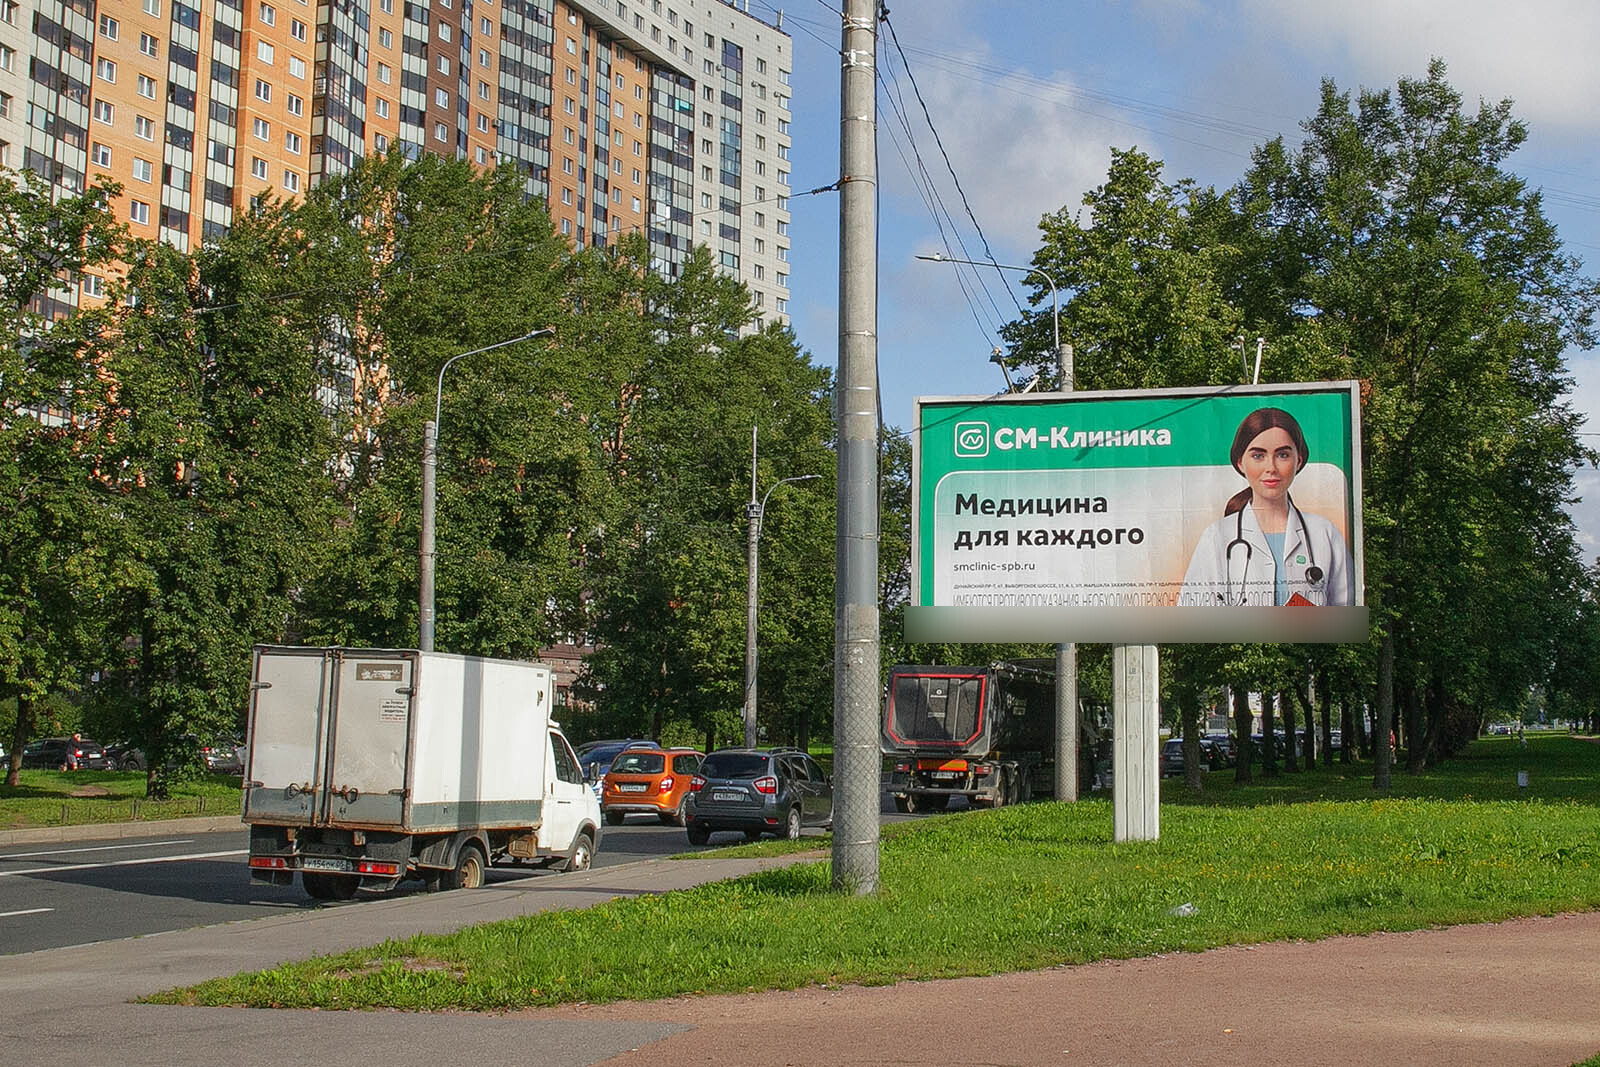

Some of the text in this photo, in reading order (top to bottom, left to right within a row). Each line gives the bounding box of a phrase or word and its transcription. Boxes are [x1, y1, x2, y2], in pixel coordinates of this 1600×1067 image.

[994, 426, 1172, 450] СМ-Клиника
[955, 493, 1108, 518] Медицина
[954, 527, 1145, 551] для каждого
[953, 560, 1036, 572] smclinic-spb.ru
